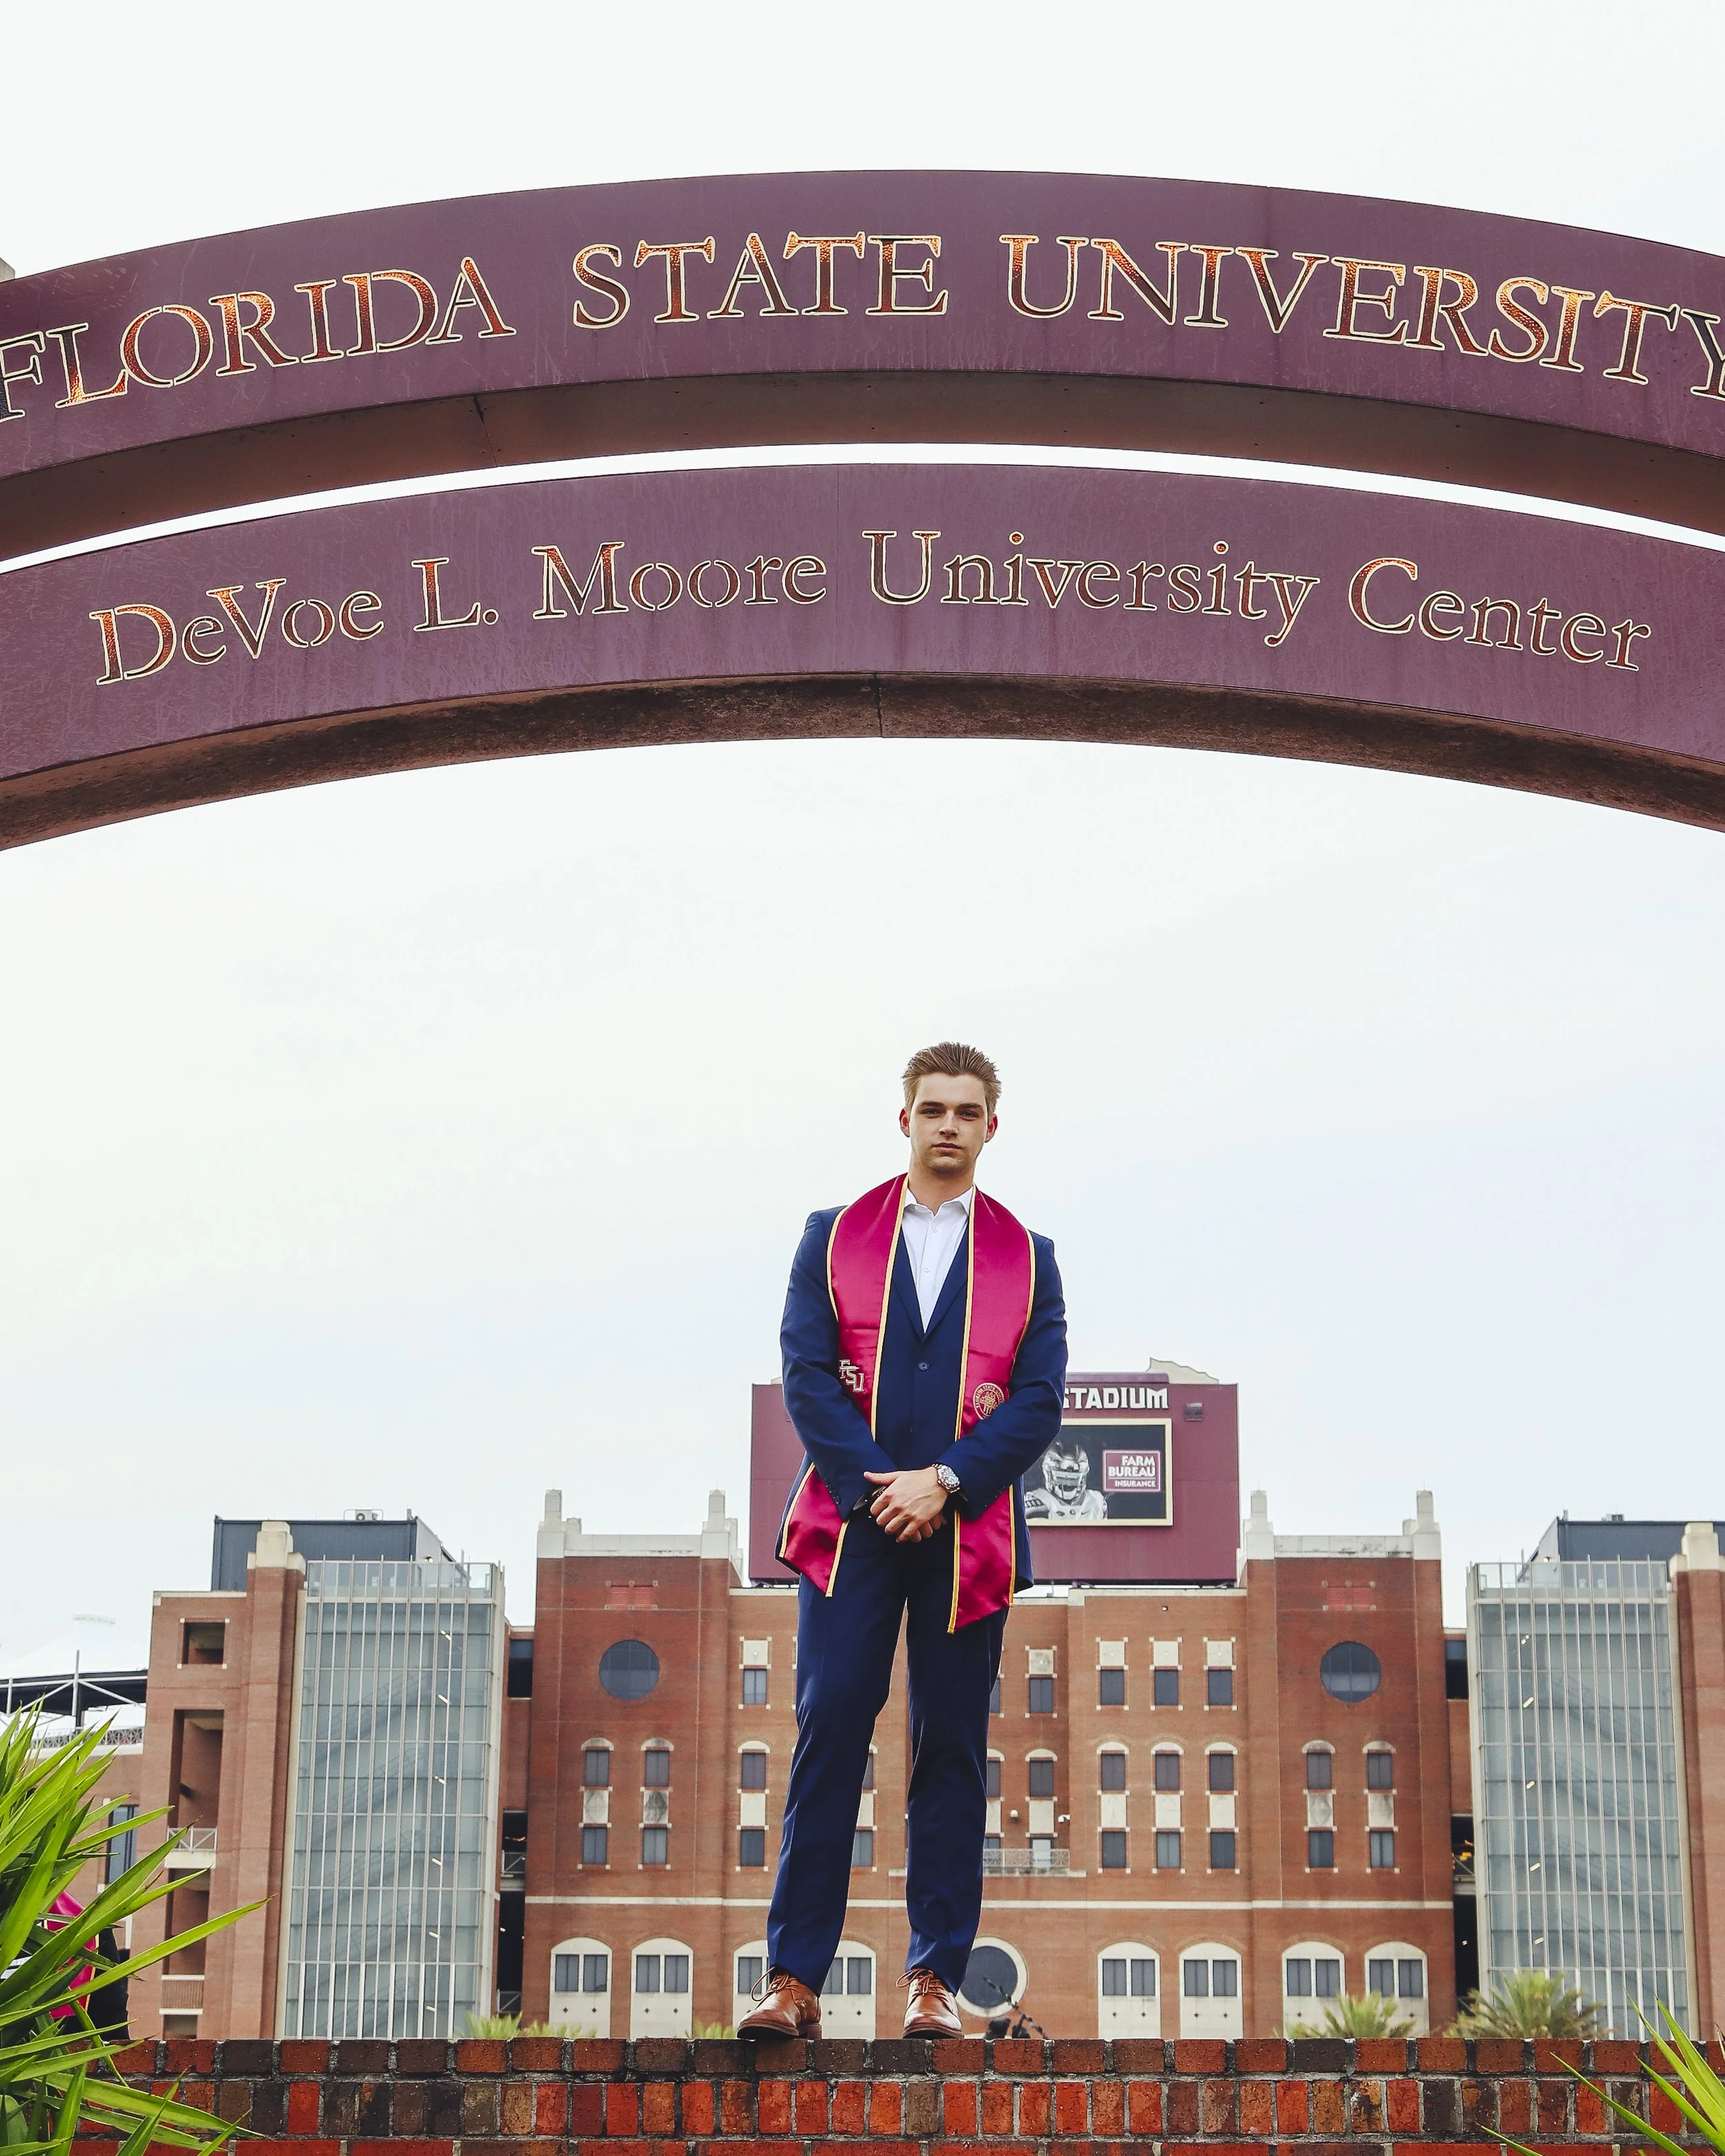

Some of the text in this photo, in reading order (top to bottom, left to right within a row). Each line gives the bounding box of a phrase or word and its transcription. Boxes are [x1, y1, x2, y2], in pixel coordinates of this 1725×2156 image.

[0, 256, 516, 422] FLORIDA
[573, 230, 949, 329] STATE
[89, 529, 1652, 685] DeVoe L. Moore University Center
[839, 1359, 864, 1392] FSU
[1108, 1466, 1156, 1477] BUREAU
[1121, 1455, 1156, 1466] FARM
